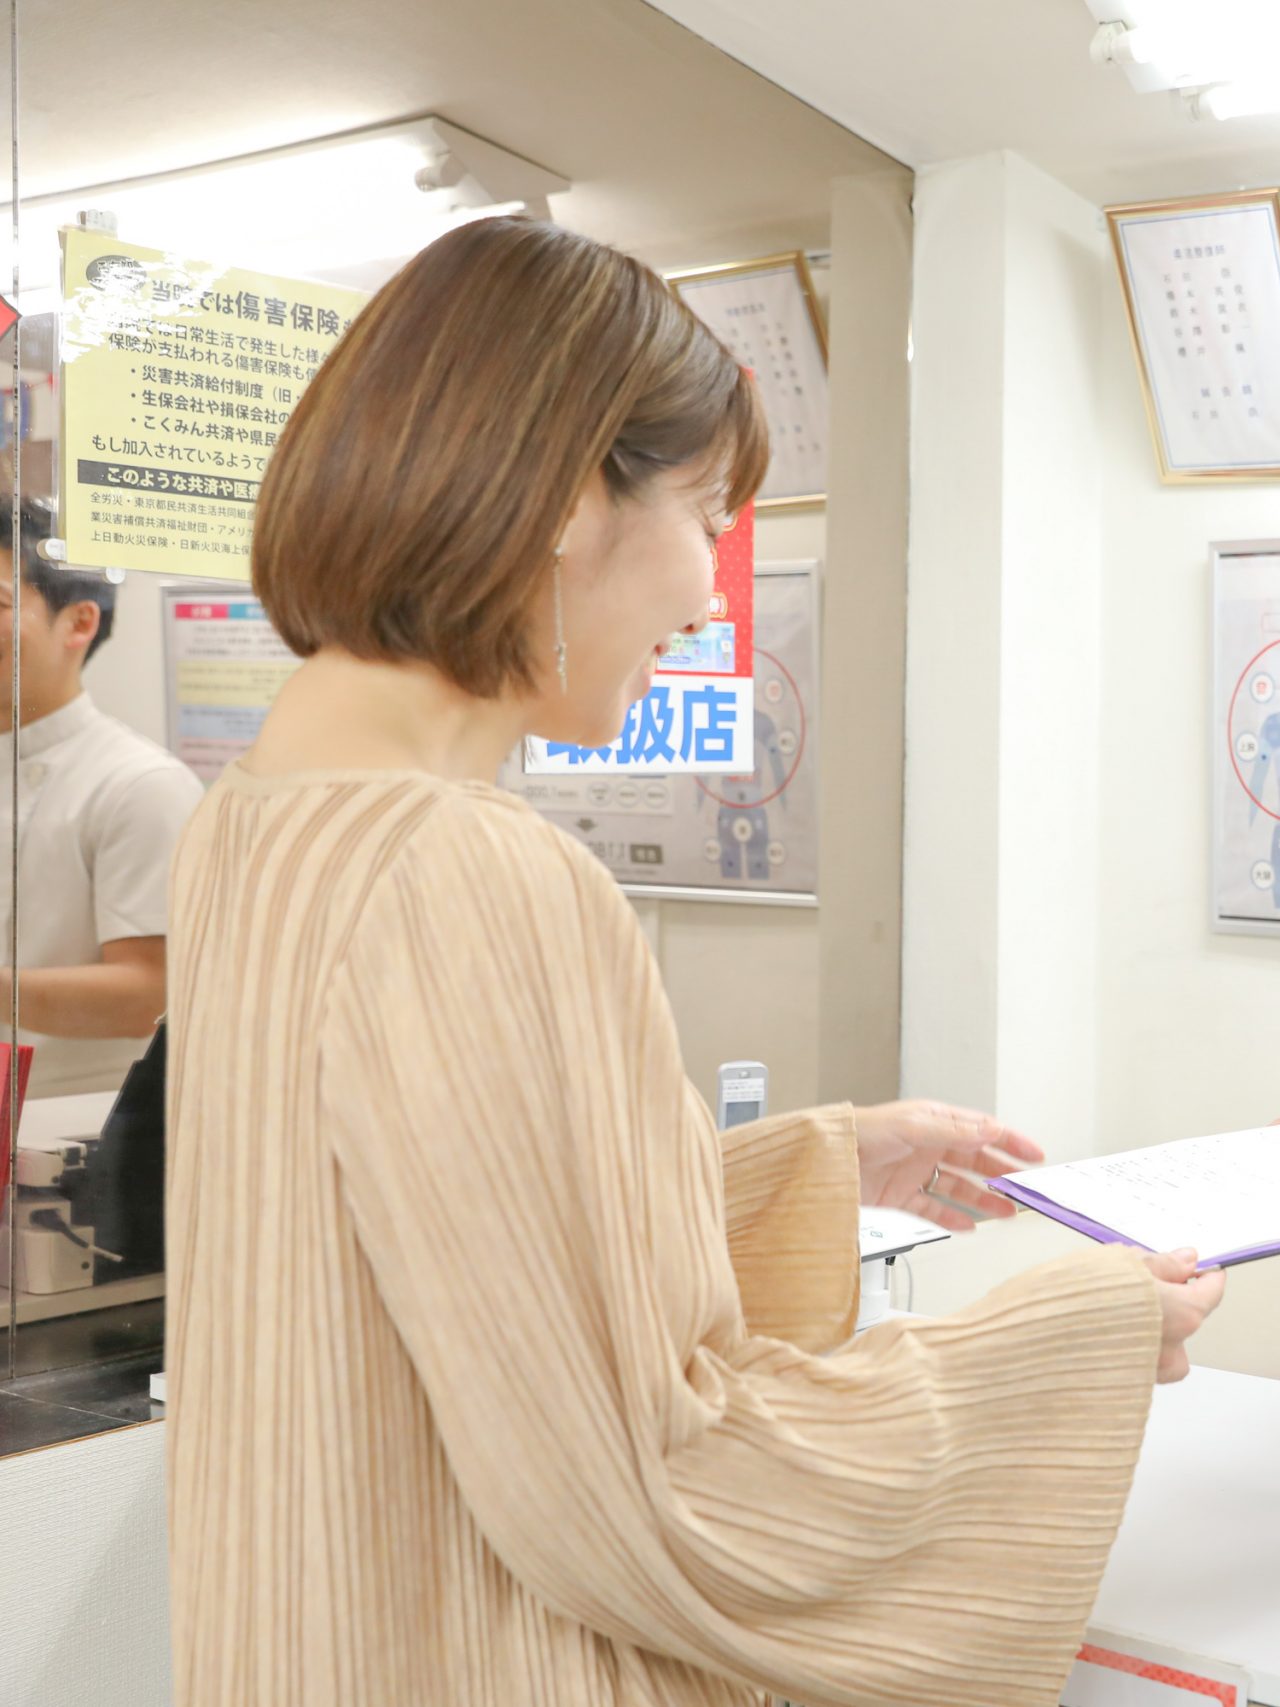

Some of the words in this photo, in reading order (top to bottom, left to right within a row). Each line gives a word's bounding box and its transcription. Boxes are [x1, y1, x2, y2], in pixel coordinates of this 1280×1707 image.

[152, 279, 352, 338] 当では傷害保険
